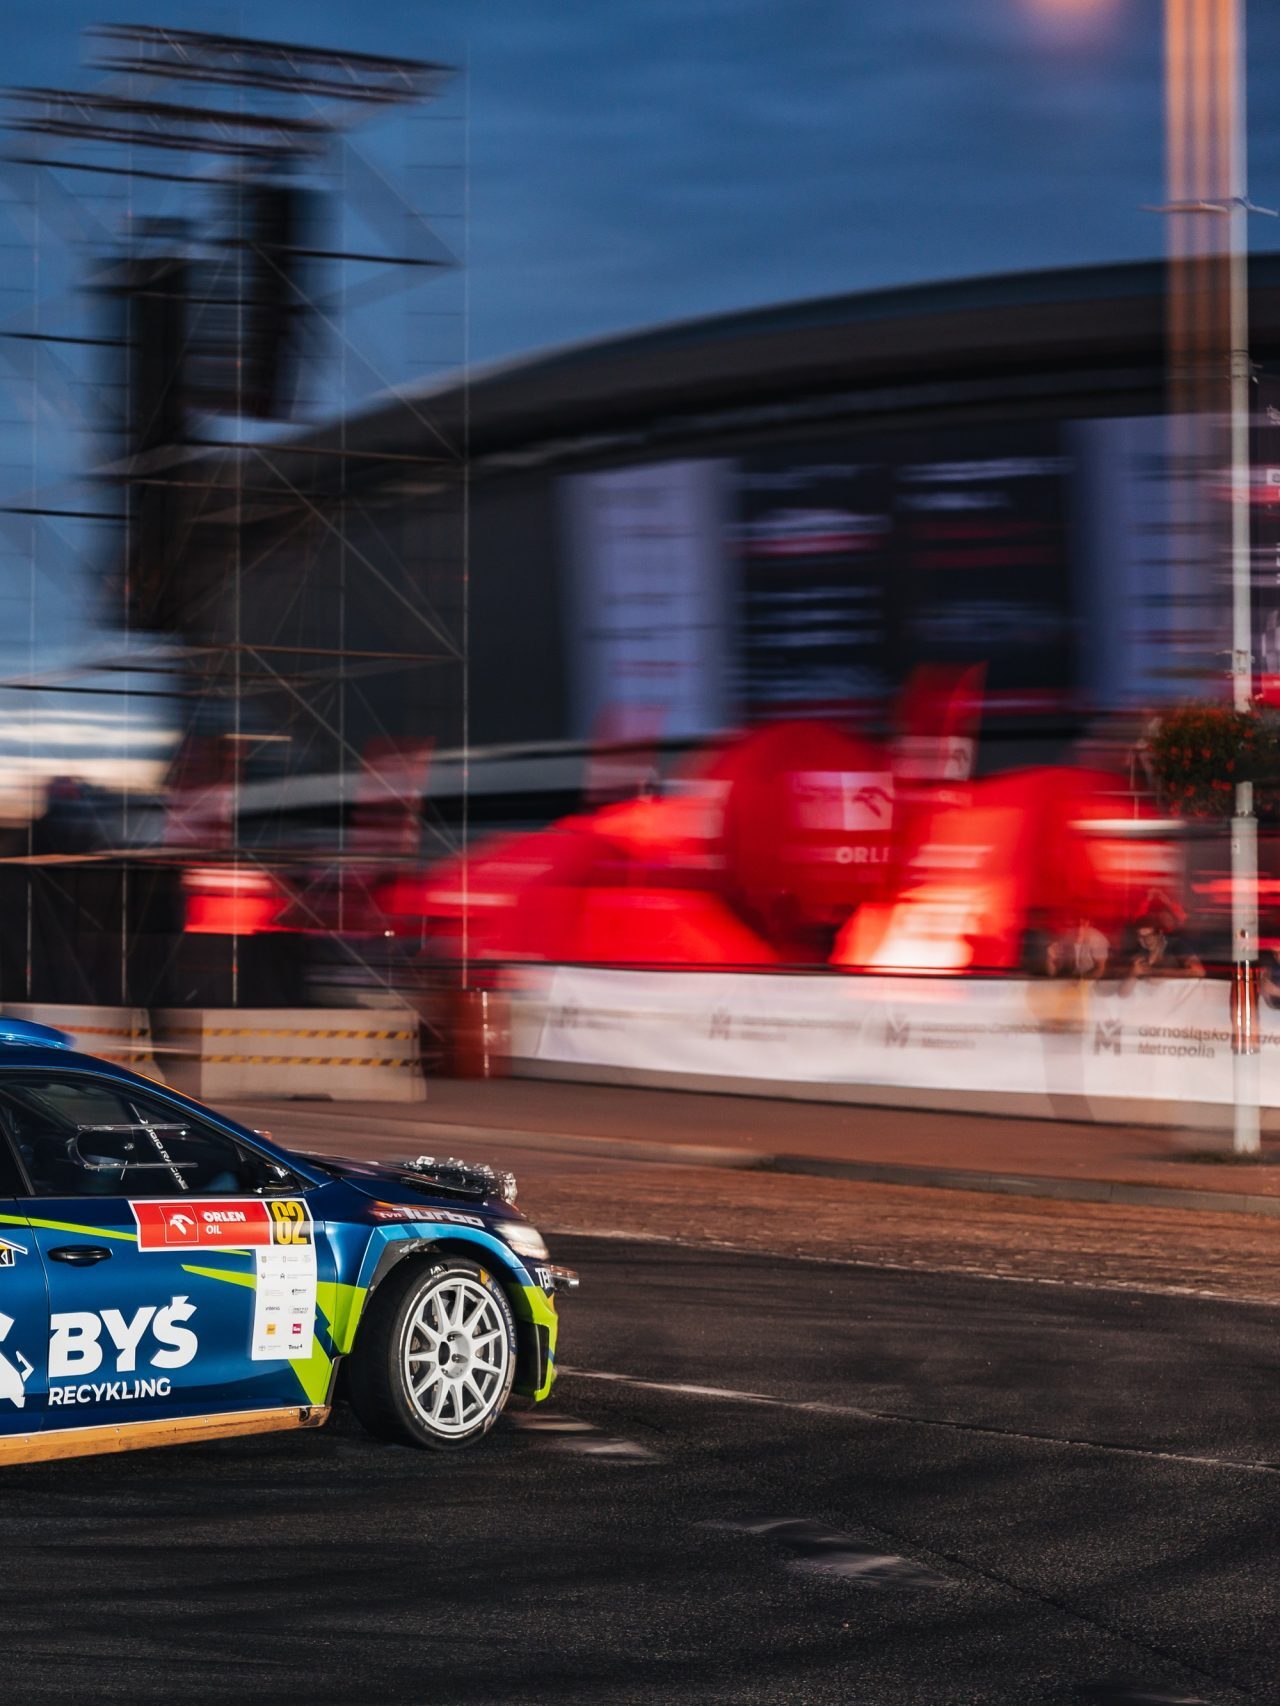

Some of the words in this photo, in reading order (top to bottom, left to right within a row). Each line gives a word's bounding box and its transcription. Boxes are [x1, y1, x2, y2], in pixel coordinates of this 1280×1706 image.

[1137, 1043, 1216, 1059] Metropolia
[202, 1210, 247, 1223] ORLEN
[270, 1200, 308, 1245] 62
[392, 1206, 486, 1228] Turbo
[205, 1225, 223, 1235] OIL
[47, 1295, 199, 1378] BYŚ
[47, 1377, 172, 1406] RECYKLING
